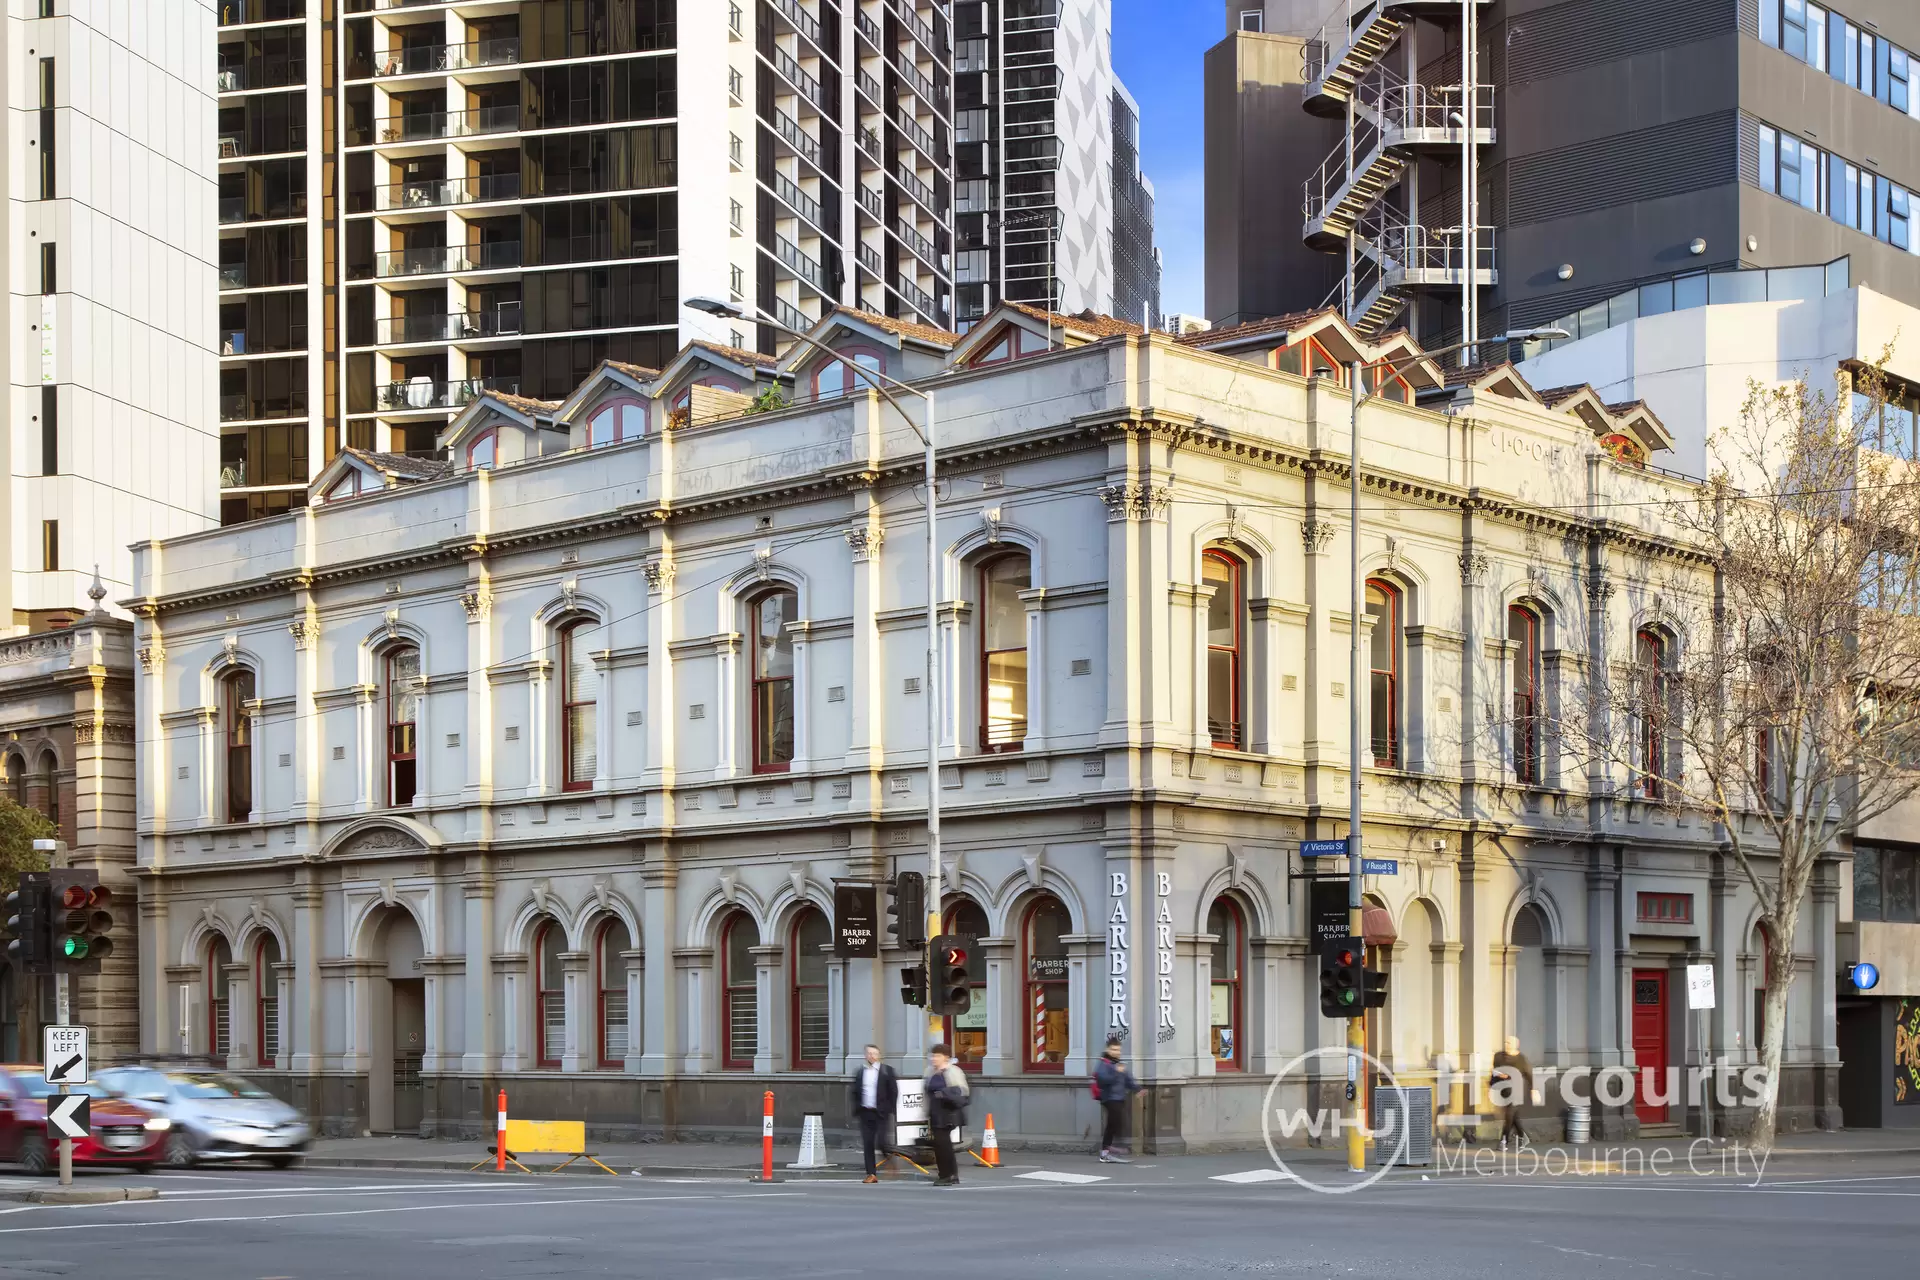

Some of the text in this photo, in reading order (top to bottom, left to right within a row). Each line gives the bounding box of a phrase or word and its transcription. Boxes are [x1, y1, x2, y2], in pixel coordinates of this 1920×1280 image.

[1310, 842, 1344, 851] Victoria St
[1370, 861, 1393, 870] Russell St
[842, 928, 872, 937] BARBER
[1317, 924, 1350, 933] BARBER
[847, 937, 867, 945] SHOP
[1109, 872, 1130, 1028] BARBER
[1157, 872, 1175, 1028] BARBER
[1036, 960, 1069, 968] BARBER
[52, 1031, 80, 1041] KEEP
[1157, 1028, 1175, 1043] SHOP
[53, 1043, 79, 1052] LEFT
[903, 1094, 923, 1104] MC
